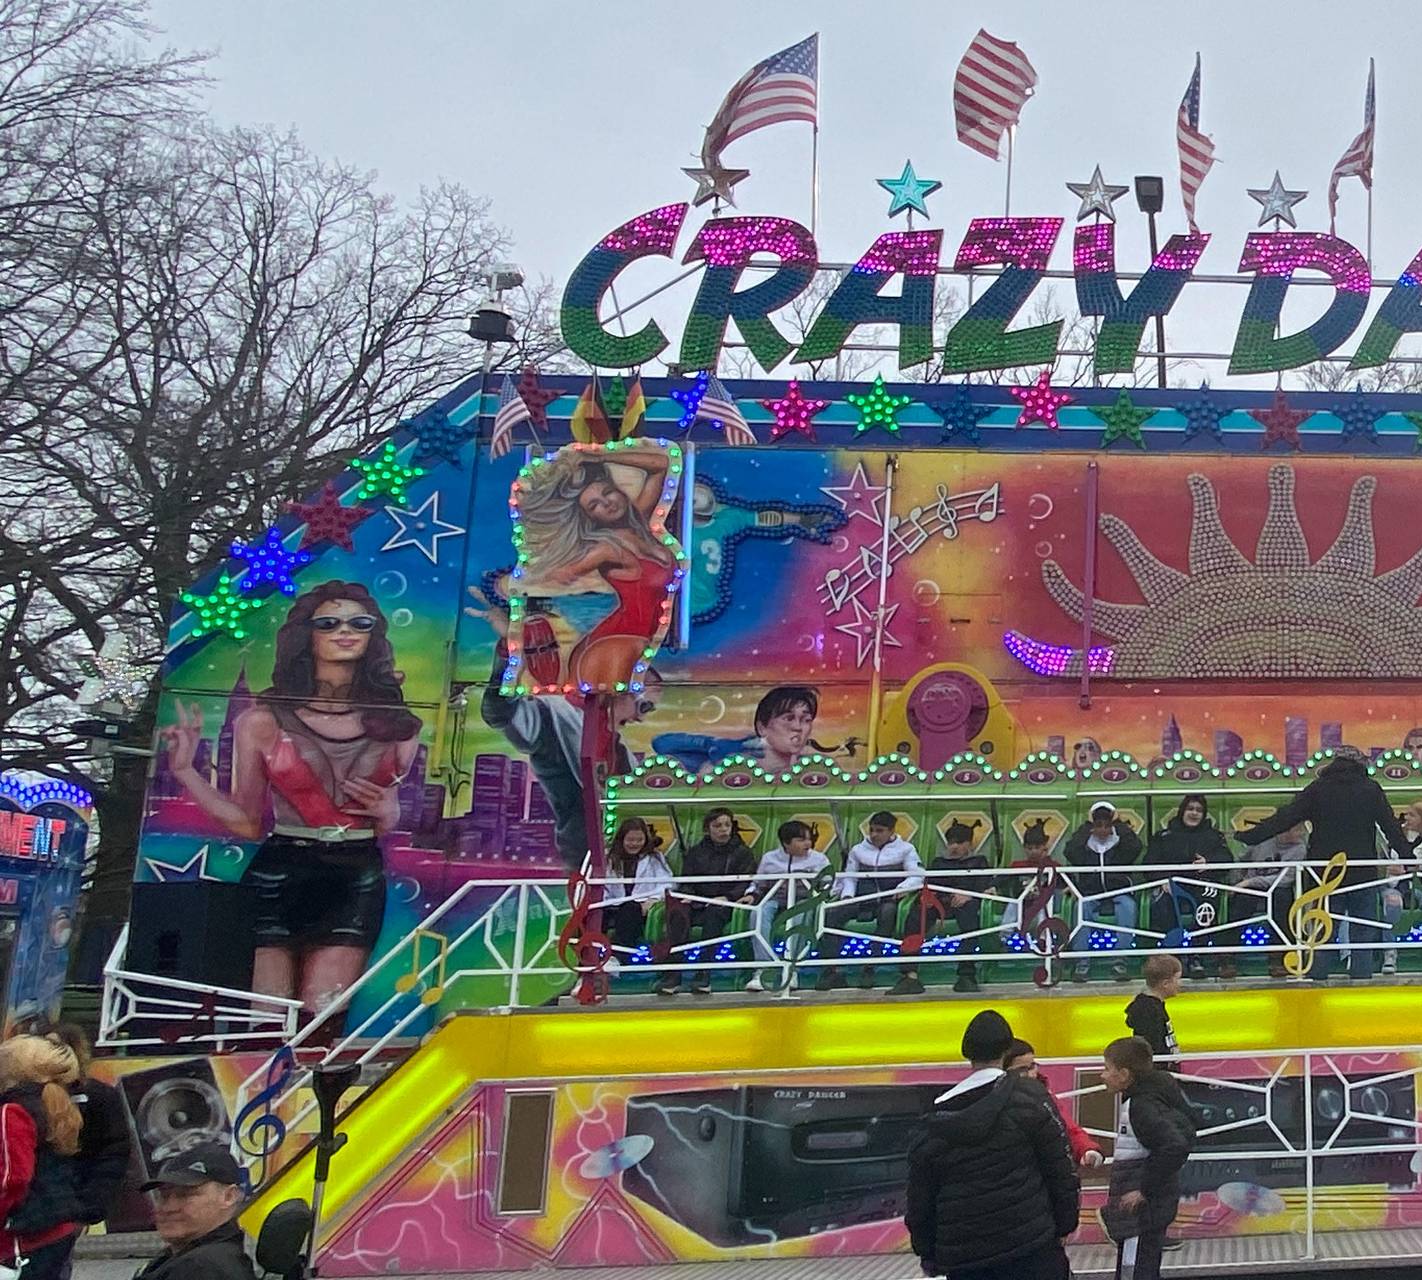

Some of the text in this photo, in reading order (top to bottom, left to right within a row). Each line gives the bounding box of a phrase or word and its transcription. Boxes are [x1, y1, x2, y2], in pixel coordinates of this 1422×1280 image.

[560, 202, 1212, 376] CRAZY
[888, 774, 896, 782] 4
[963, 773, 970, 781] 5
[1112, 771, 1119, 780] 7
